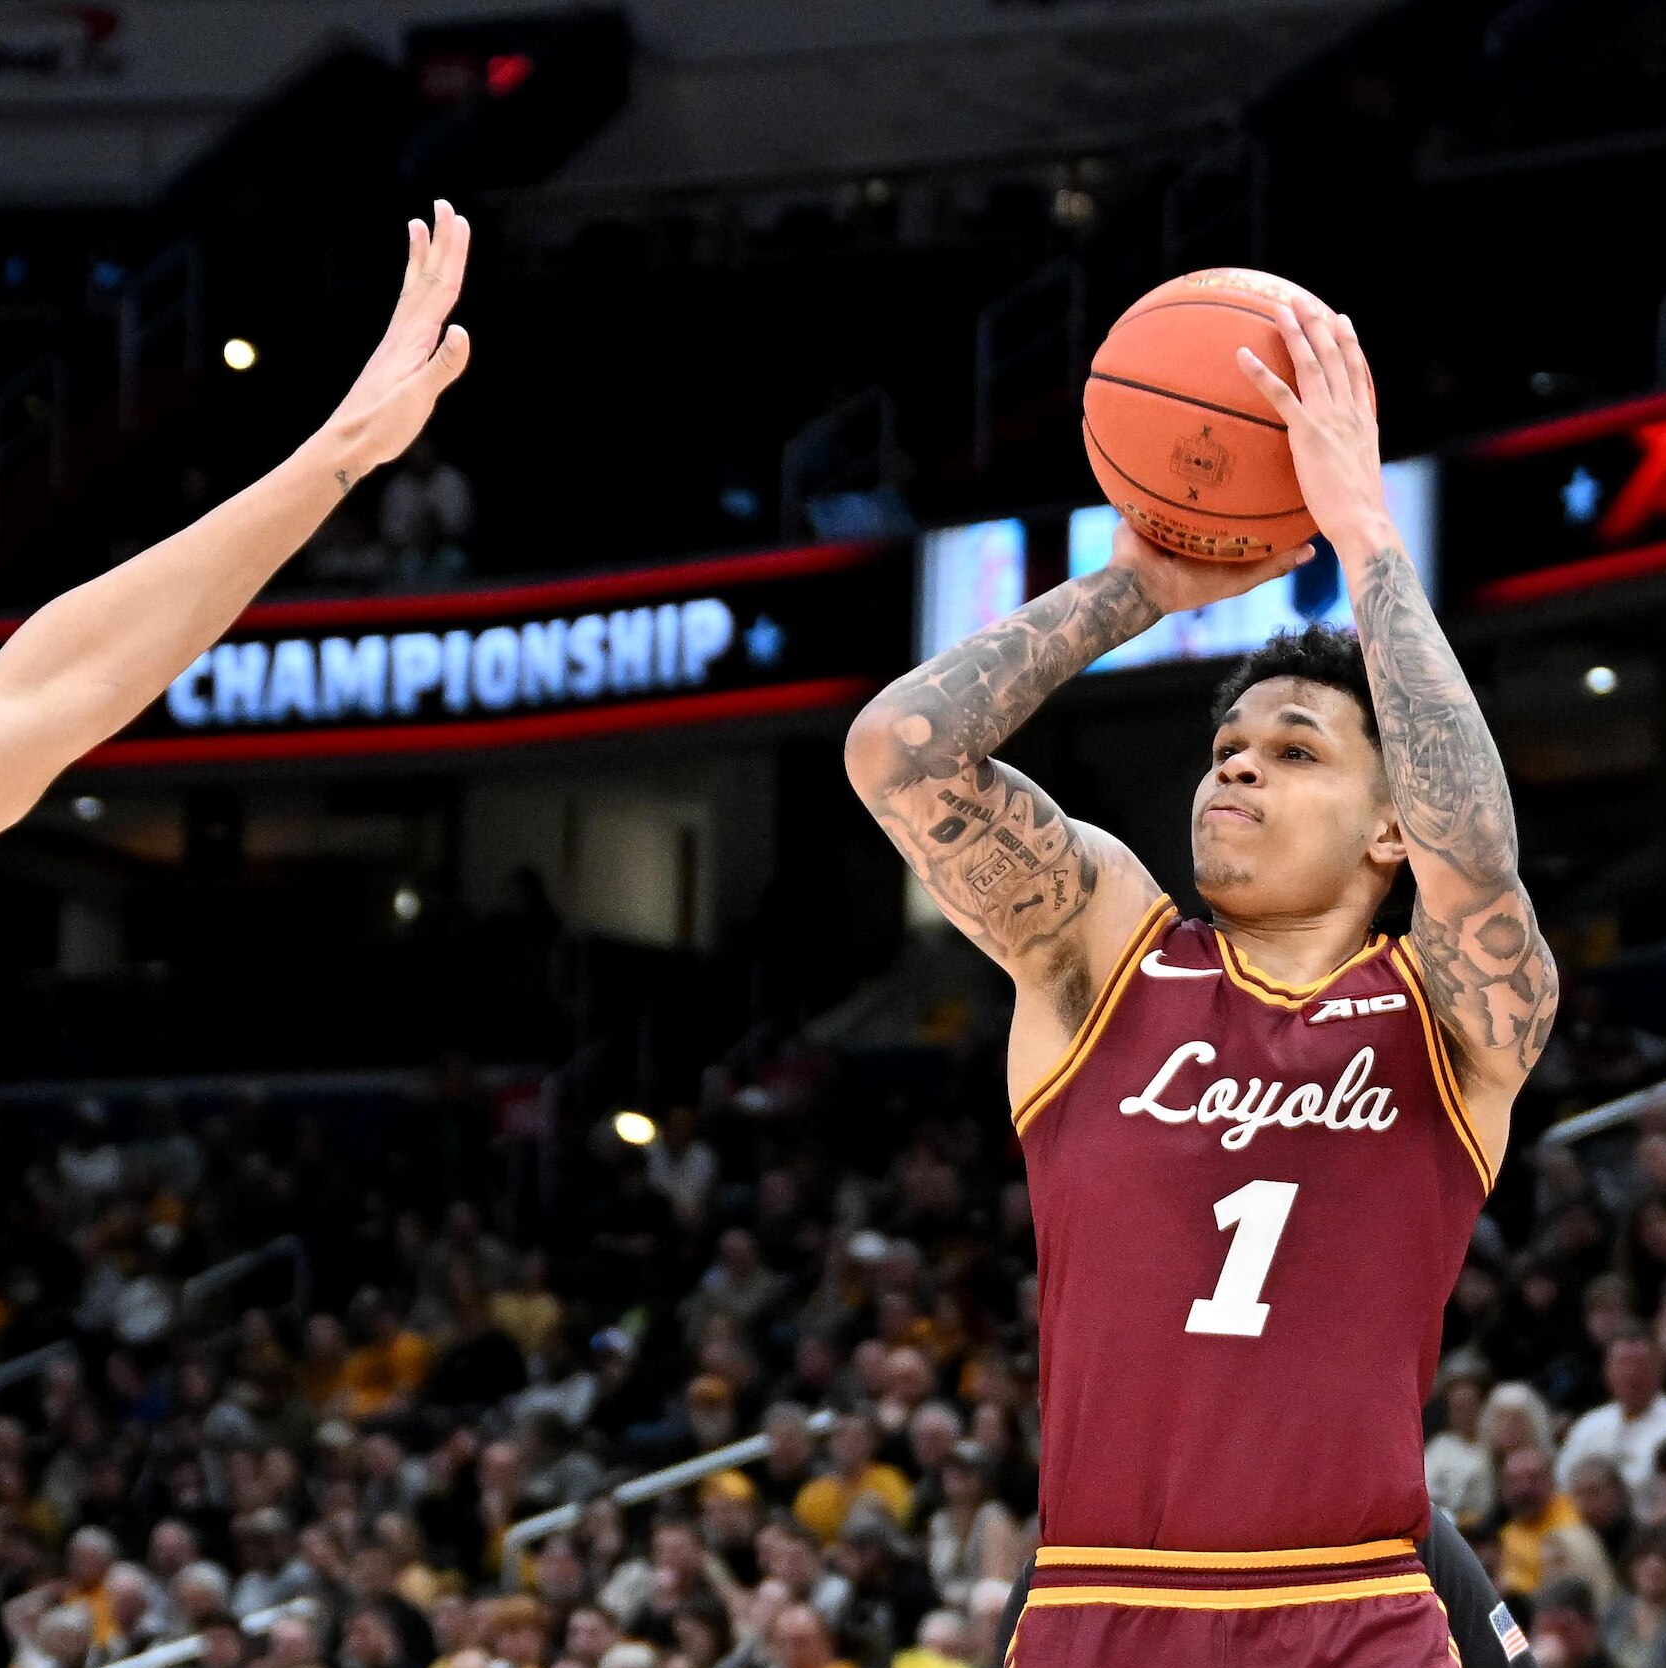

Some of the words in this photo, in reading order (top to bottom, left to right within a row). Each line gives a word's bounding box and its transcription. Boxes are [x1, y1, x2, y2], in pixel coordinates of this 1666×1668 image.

[167, 598, 733, 728] CHAMPIONSHIP
[1310, 991, 1408, 1022] A10
[1119, 1040, 1399, 1152] Loyola
[1183, 1179, 1300, 1338] 1
